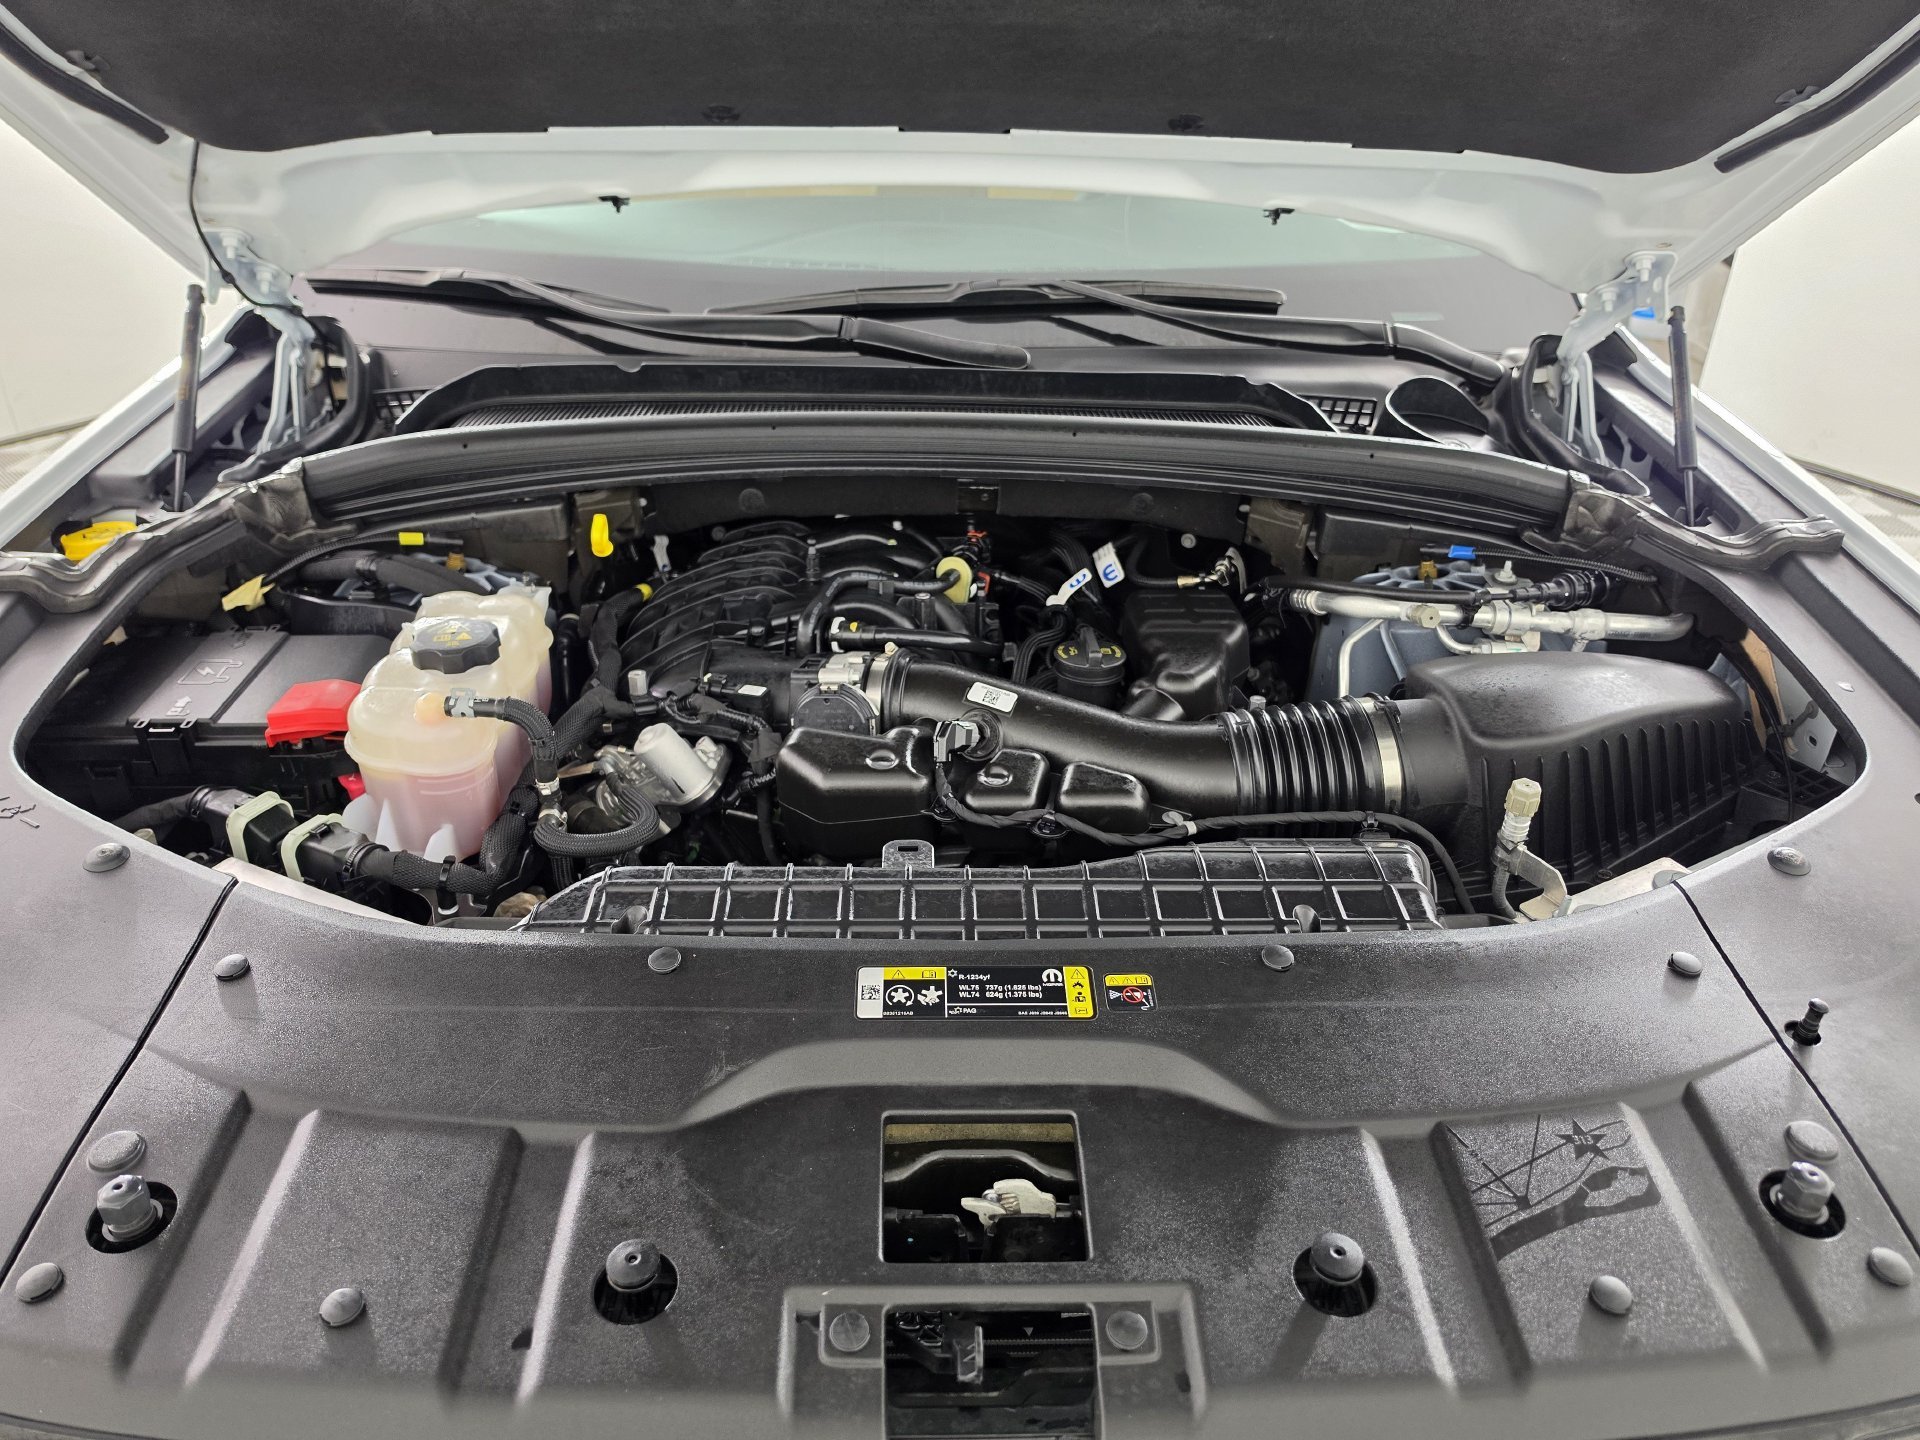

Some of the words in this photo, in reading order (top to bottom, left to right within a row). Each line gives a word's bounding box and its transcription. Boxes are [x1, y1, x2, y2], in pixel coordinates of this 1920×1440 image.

[985, 984, 1003, 992] 737g
[1027, 984, 1042, 992] lbs)
[985, 991, 1004, 999] 624g
[1028, 991, 1043, 999] lbs)
[1571, 1134, 1594, 1145] 313
